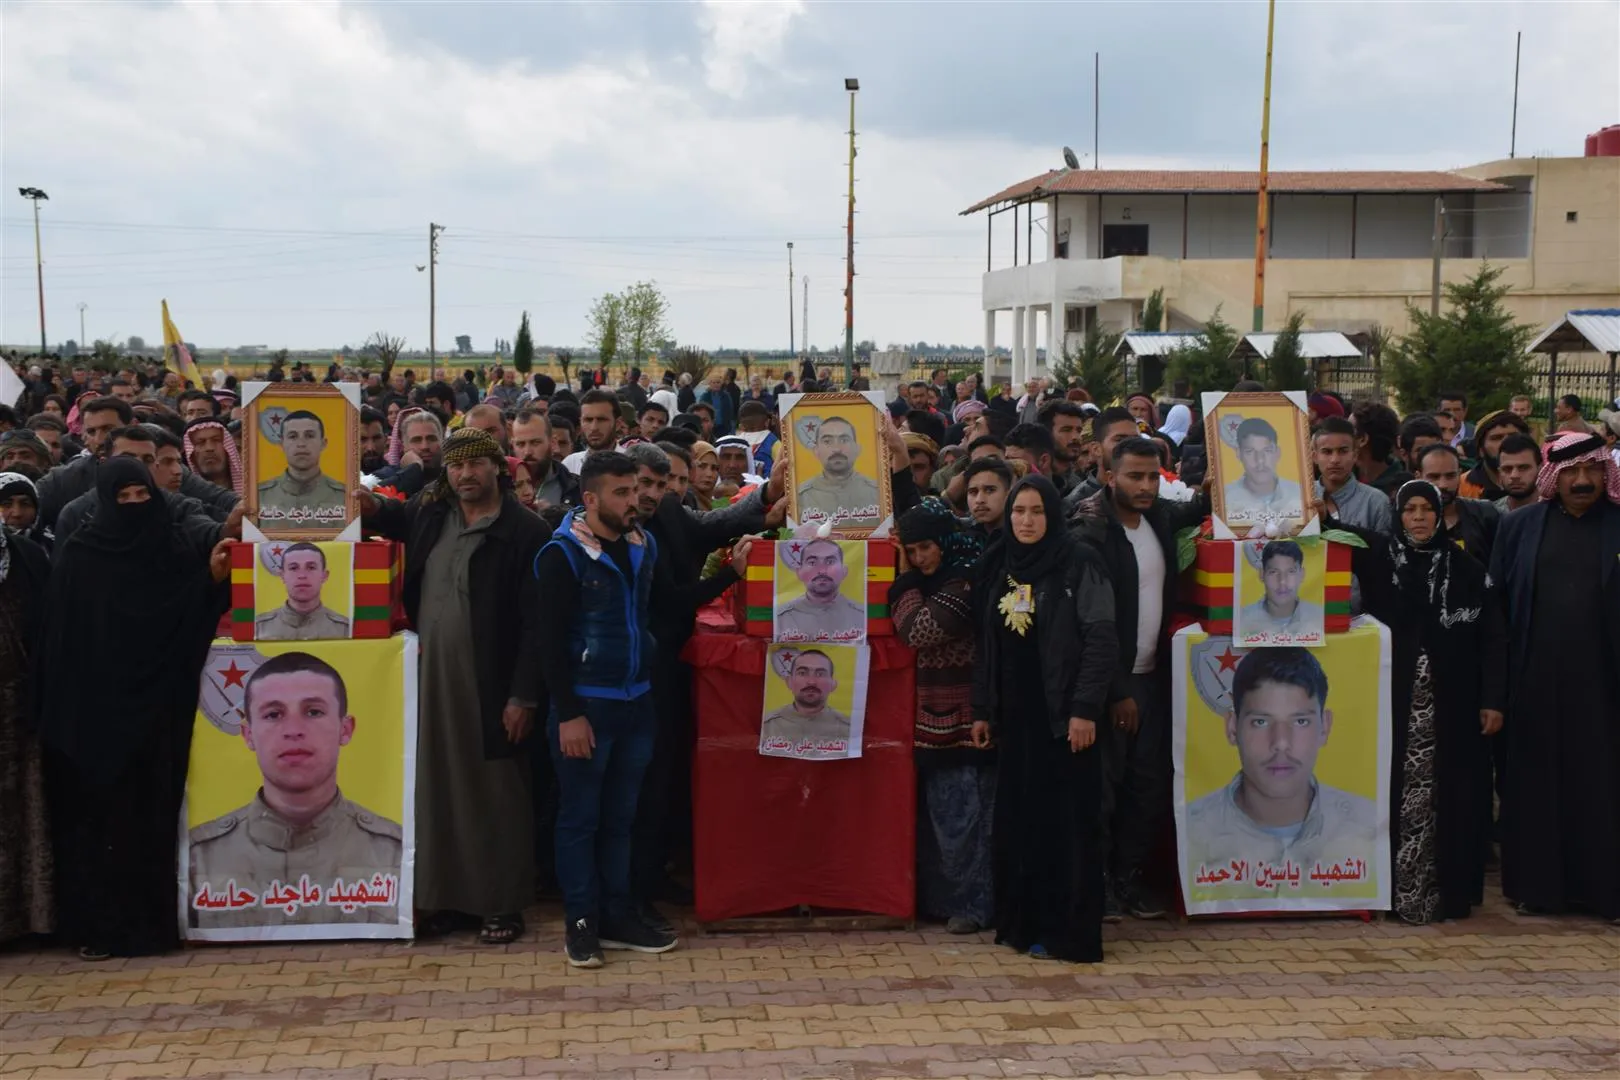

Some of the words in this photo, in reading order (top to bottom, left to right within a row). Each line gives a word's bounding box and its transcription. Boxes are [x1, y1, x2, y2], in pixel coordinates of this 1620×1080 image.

[1196, 860, 1249, 884] الاحمد
[1255, 859, 1300, 888] ياسين
[1310, 858, 1366, 886] الشهيد
[196, 882, 256, 908] حاسه
[264, 876, 320, 912] ماجد
[328, 873, 396, 910] الشهيد
